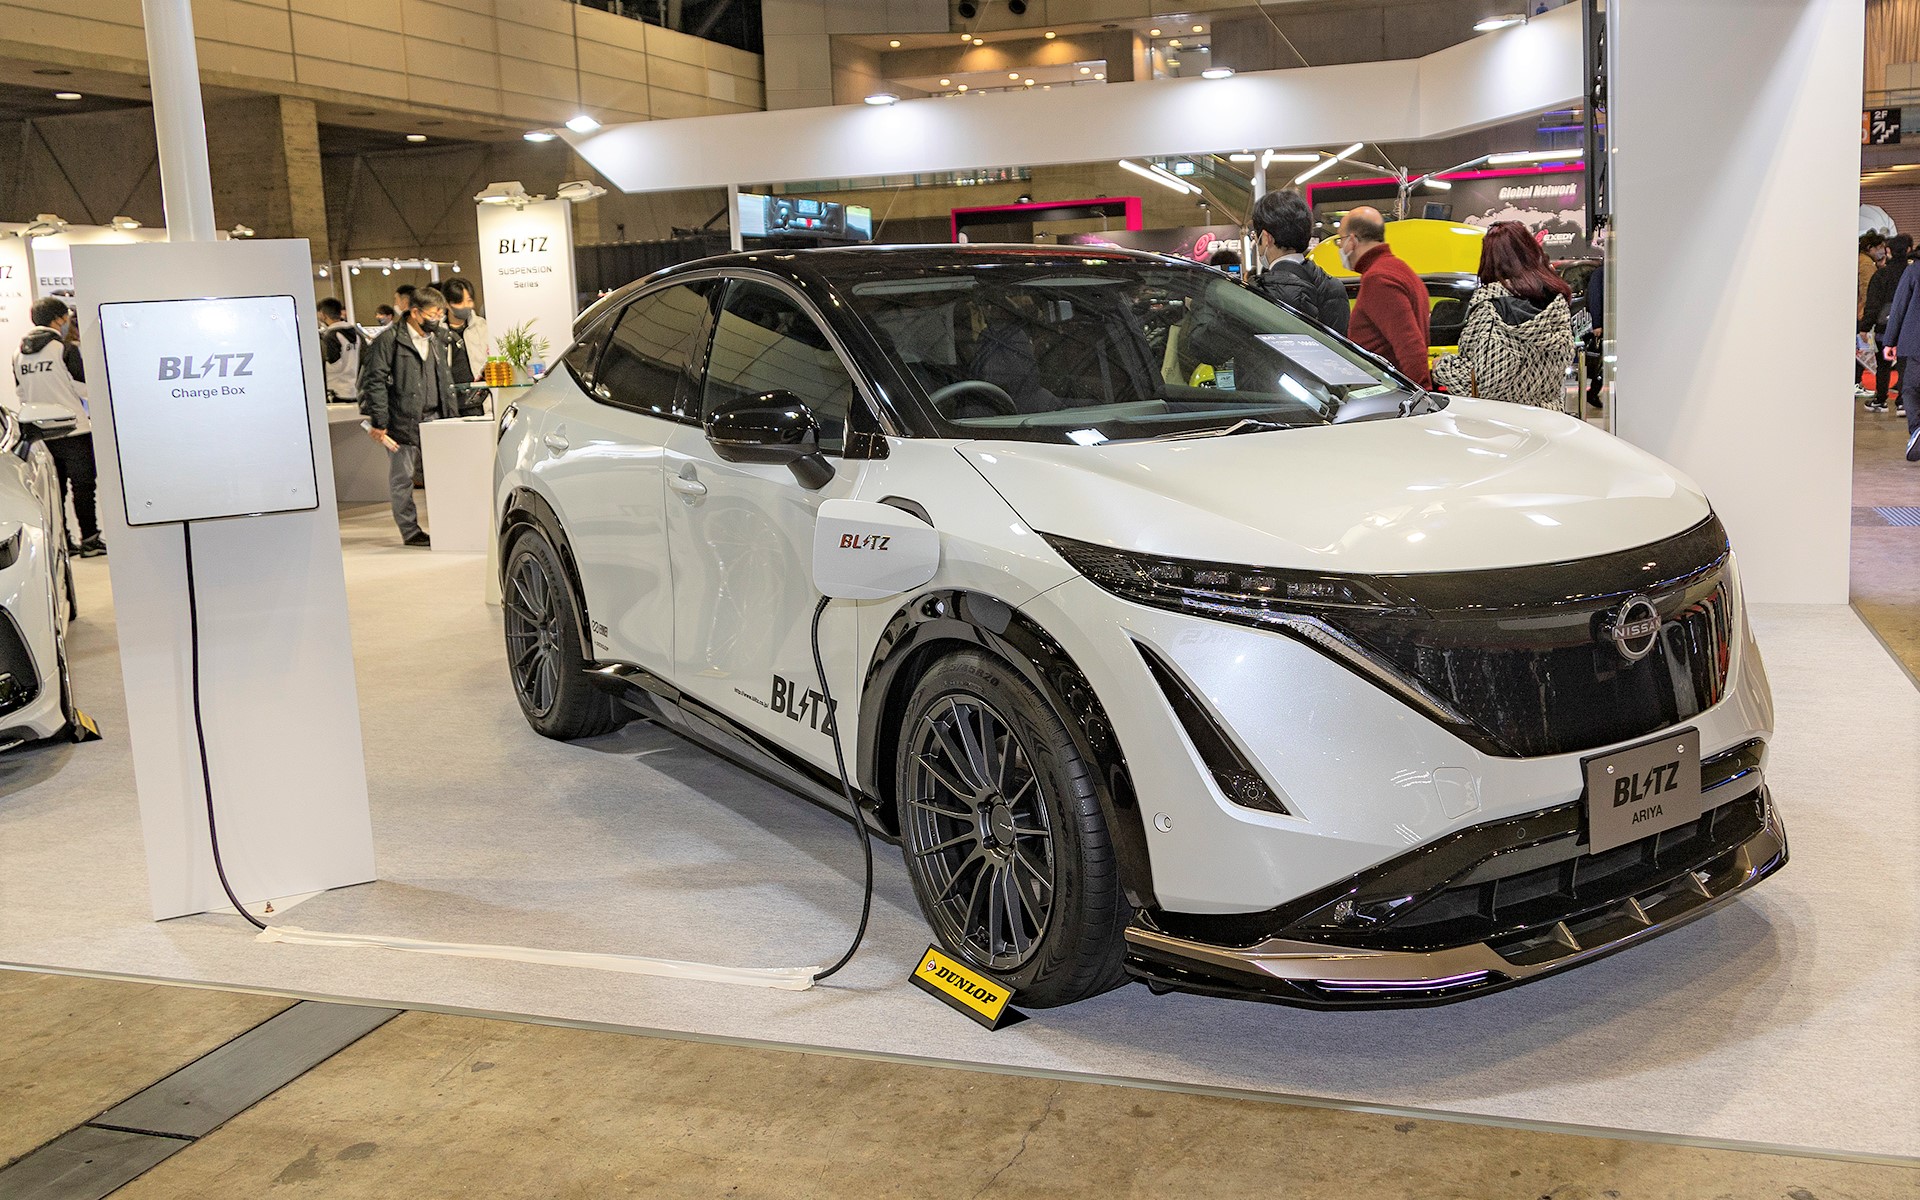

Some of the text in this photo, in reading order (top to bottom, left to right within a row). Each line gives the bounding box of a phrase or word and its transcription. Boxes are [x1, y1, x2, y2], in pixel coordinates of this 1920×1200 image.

[1874, 110, 1888, 119] 2F
[1499, 183, 1577, 200] Global Network
[1543, 232, 1576, 241] EXEDY
[498, 265, 552, 276] SUSPENSION
[513, 280, 539, 289] Series
[158, 352, 254, 381] BLITZ
[171, 386, 246, 399] Charge Box
[839, 533, 891, 551] BLITZ
[1614, 619, 1661, 638] NISSAN
[1613, 760, 1680, 808] BLITZ
[1632, 805, 1663, 824] ARIYA
[935, 966, 998, 1004] DUNLOP
